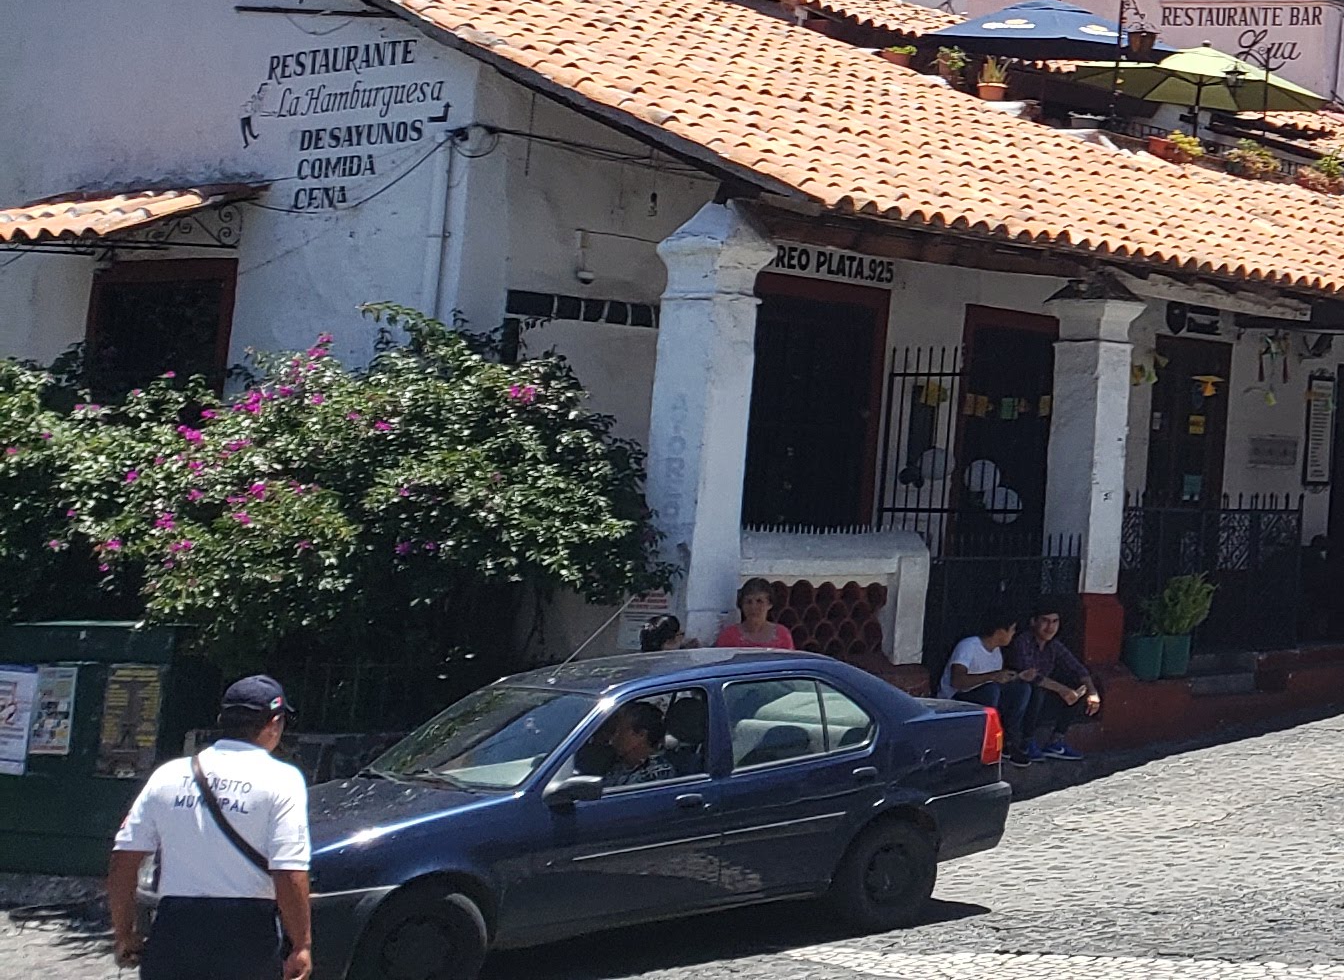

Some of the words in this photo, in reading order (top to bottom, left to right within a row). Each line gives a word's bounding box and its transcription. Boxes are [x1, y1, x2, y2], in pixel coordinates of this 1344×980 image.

[1161, 6, 1284, 27] RESTAURANTE
[1288, 5, 1322, 27] BAR
[267, 39, 417, 85] RESTAURANTE
[300, 80, 445, 118] Hamburguesa
[299, 119, 424, 151] DESAYUNOS
[297, 154, 376, 180] COMIDA
[293, 186, 347, 210] CENA
[767, 245, 810, 271] REO
[182, 775, 252, 794] TNSITO
[174, 795, 249, 815] MUPAL
